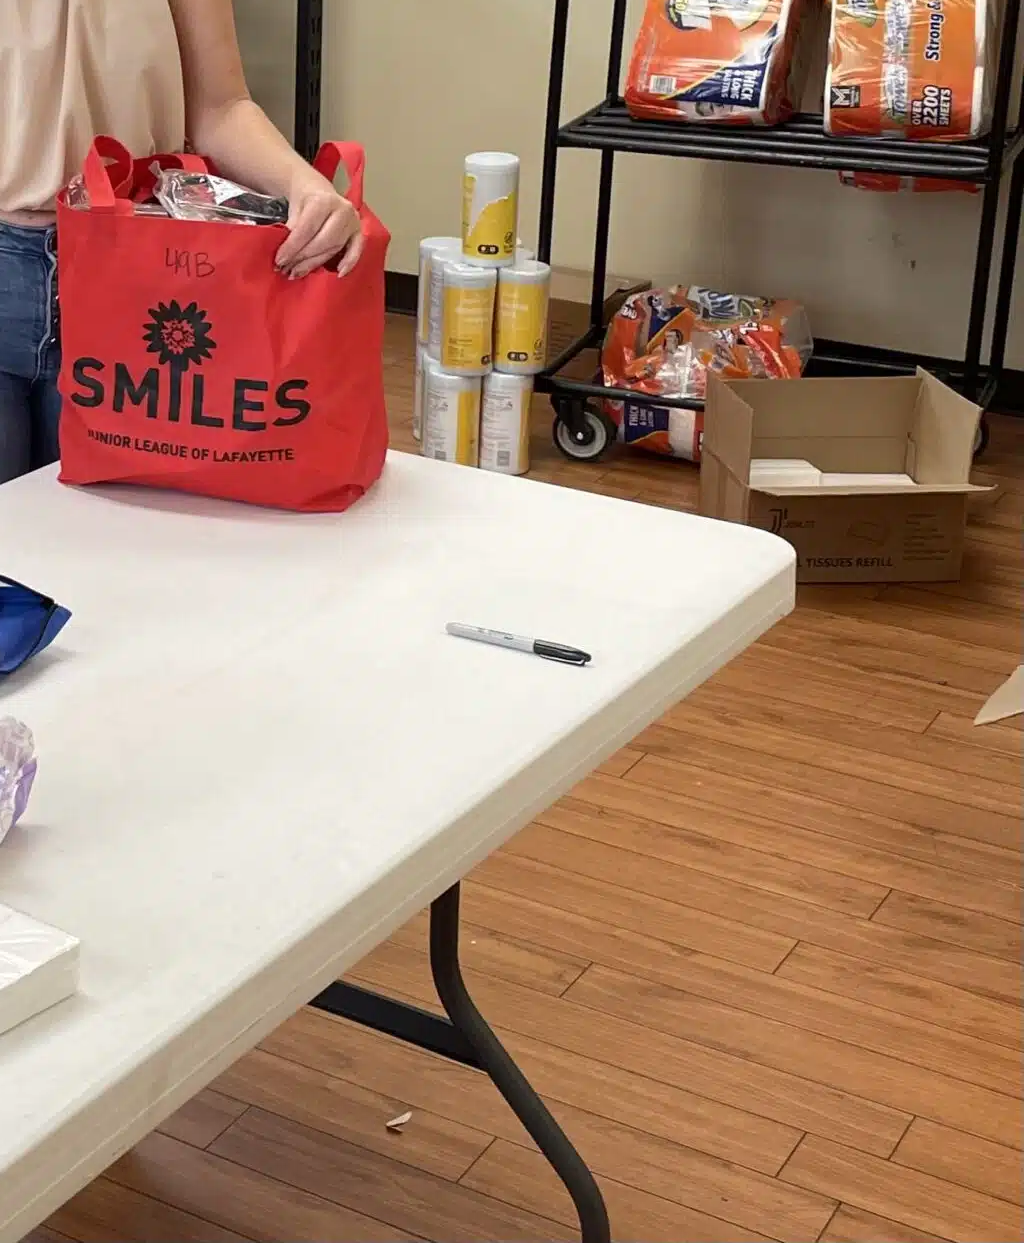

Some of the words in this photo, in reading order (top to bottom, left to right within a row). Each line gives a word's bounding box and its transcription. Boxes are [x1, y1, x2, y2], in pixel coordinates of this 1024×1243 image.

[925, 13, 944, 61] Strong
[912, 100, 921, 125] OVER
[923, 86, 939, 126] 2200
[939, 88, 952, 125] SHEETS
[165, 247, 216, 279] 49B
[70, 356, 312, 432] SMILES
[134, 438, 188, 458] LEAGUE
[191, 448, 210, 461] OF
[213, 447, 295, 463] LAFAYETTE
[806, 557, 853, 569] TISSUES
[856, 557, 894, 568] REFILL
